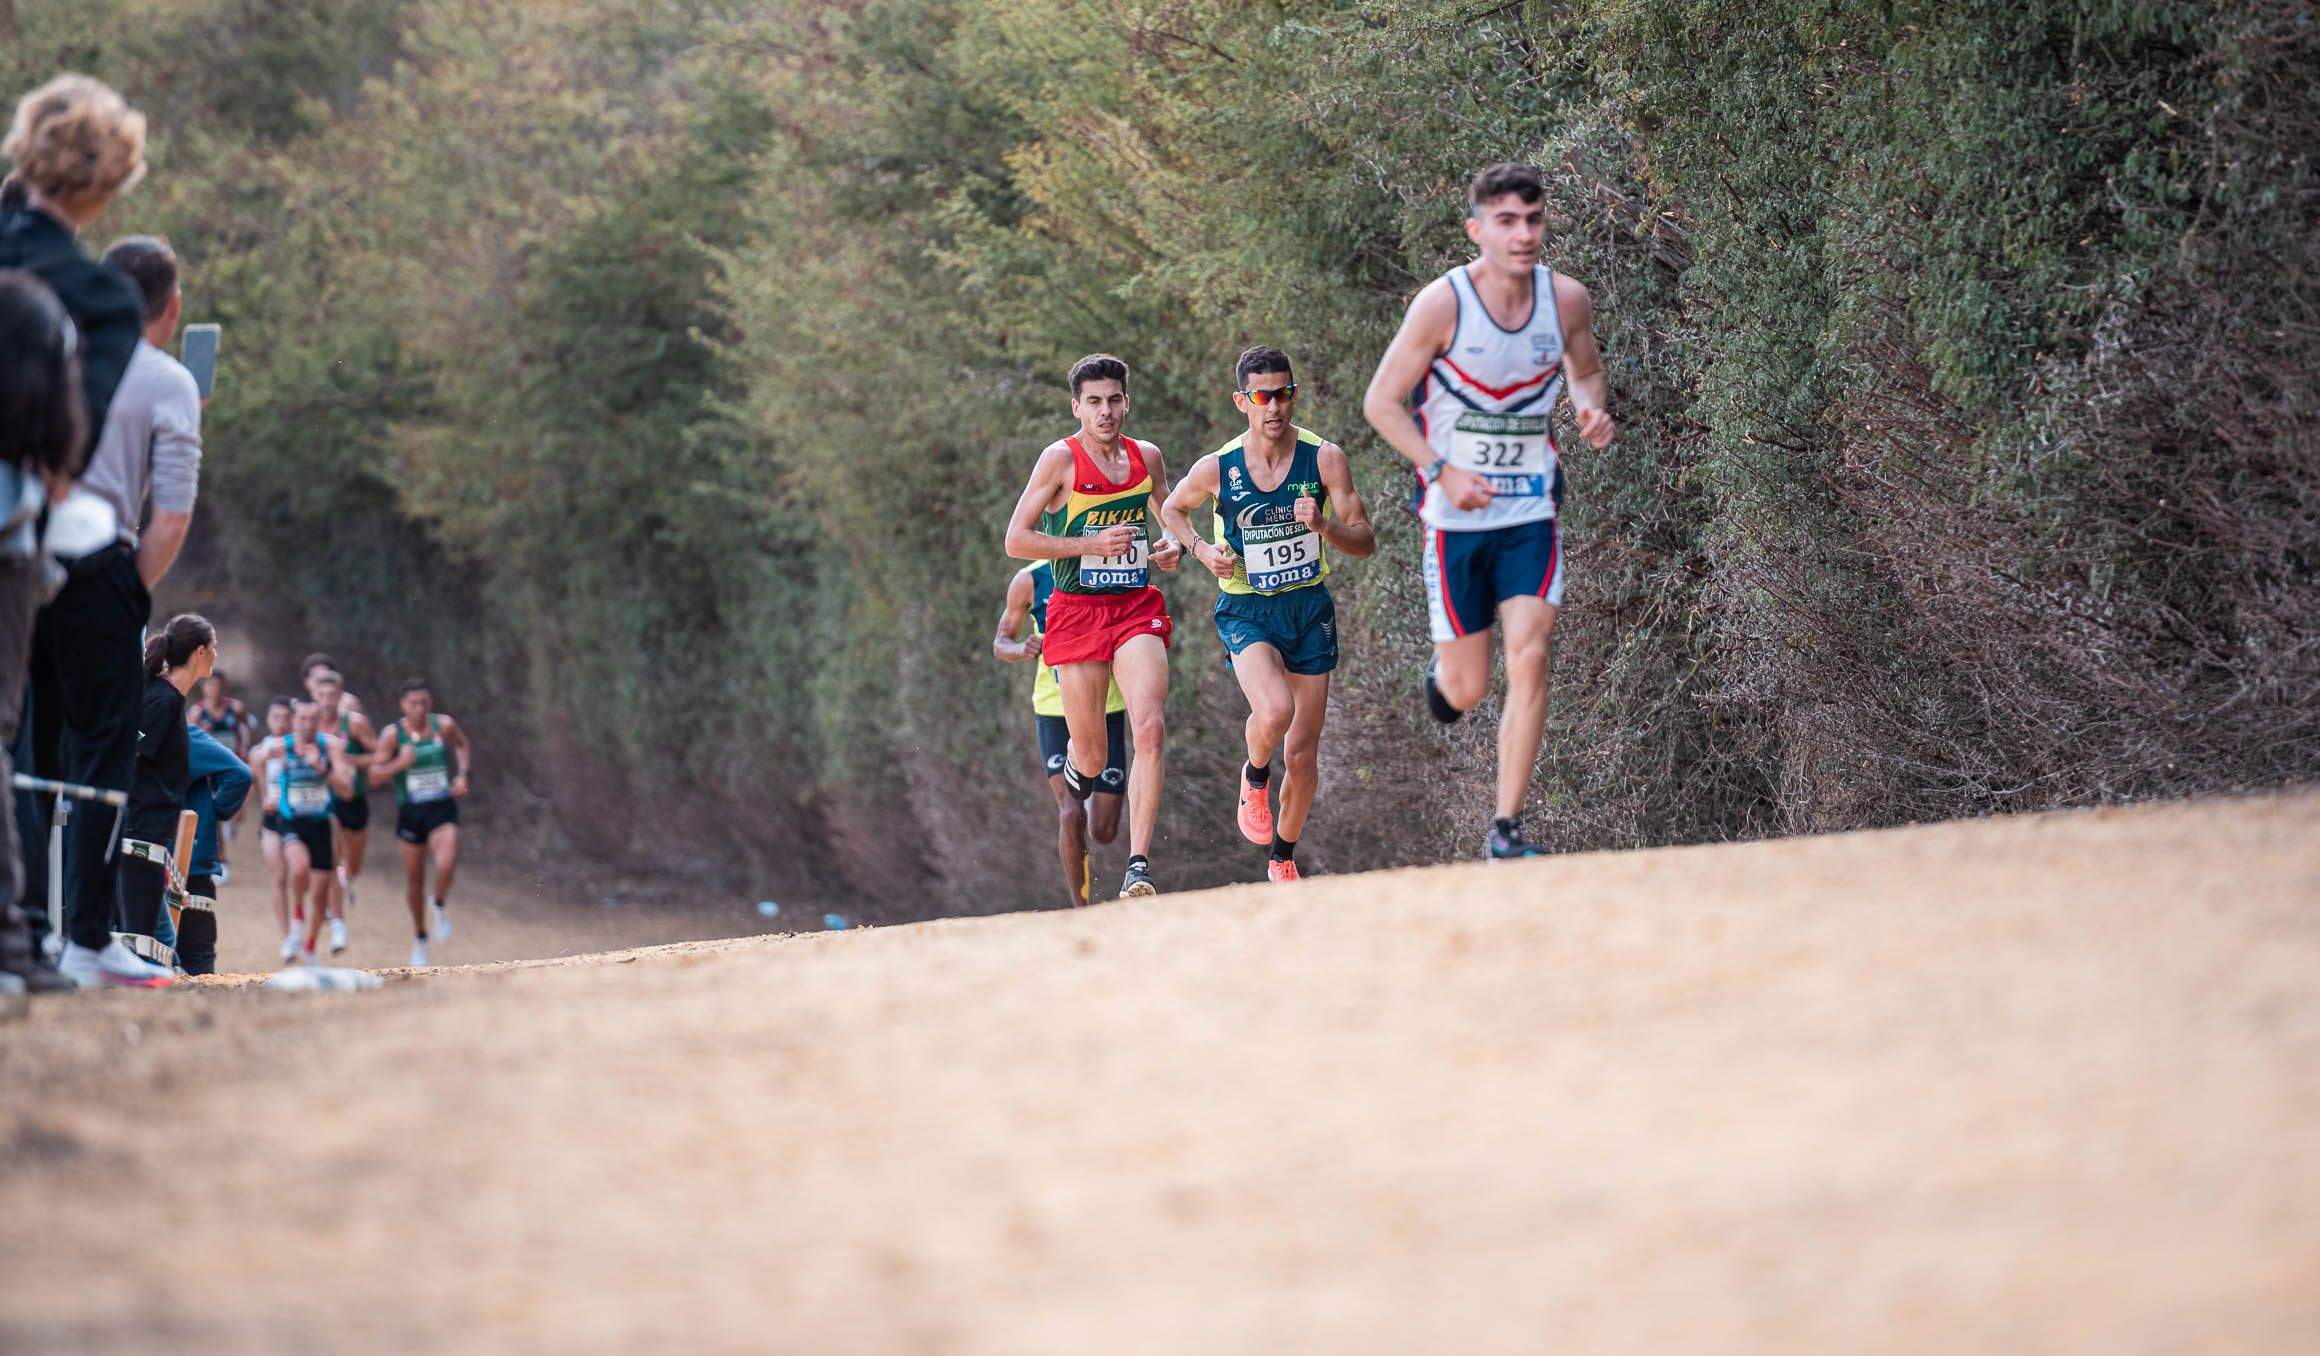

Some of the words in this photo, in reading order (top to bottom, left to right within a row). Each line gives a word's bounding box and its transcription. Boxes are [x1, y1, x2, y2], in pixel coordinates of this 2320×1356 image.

[1474, 441, 1524, 466] 322
[1264, 505, 1293, 516] CLÍNIC
[1285, 525, 1294, 536] DE
[1263, 541, 1306, 567] 195
